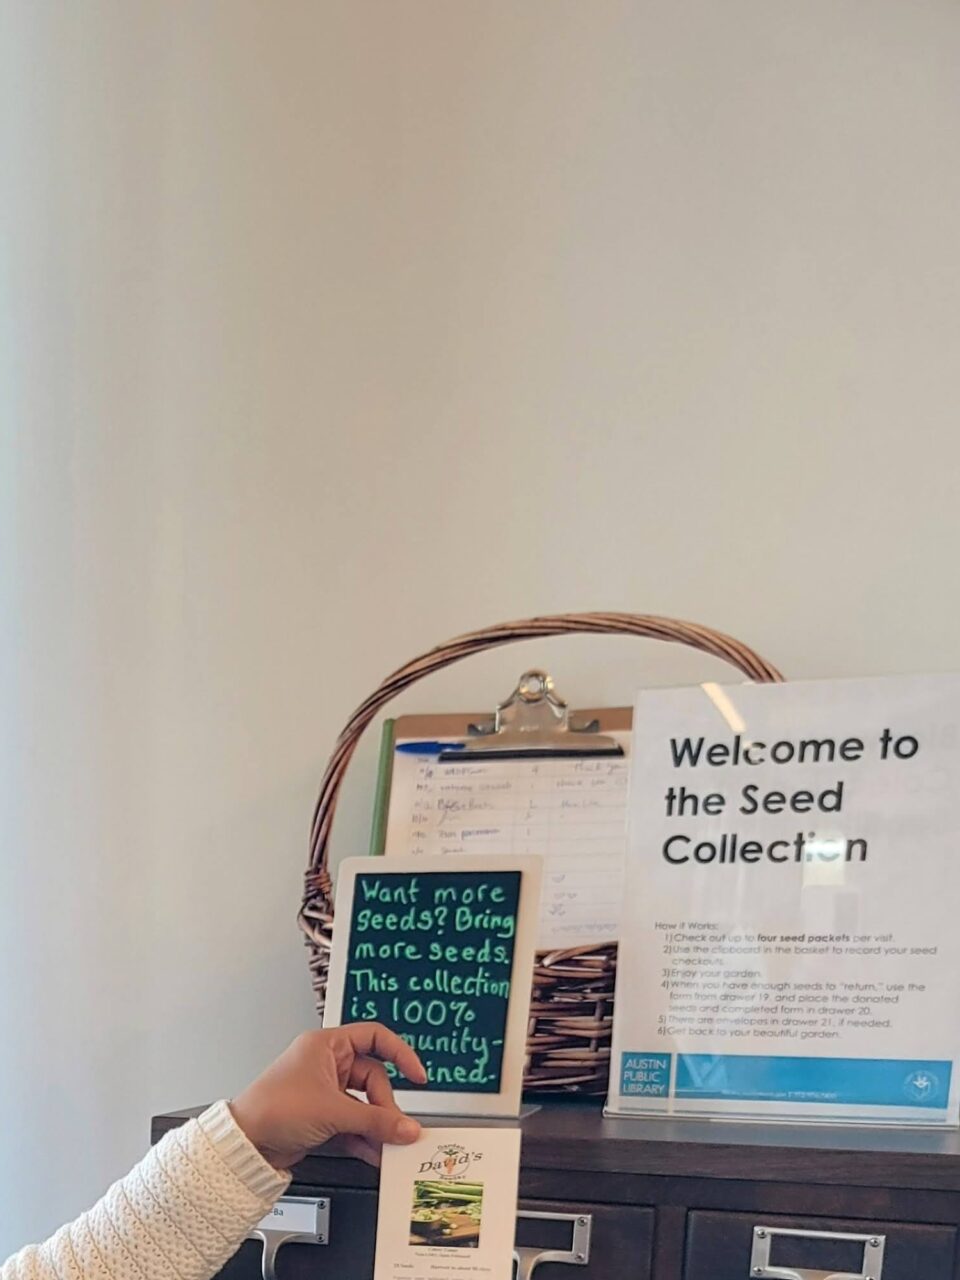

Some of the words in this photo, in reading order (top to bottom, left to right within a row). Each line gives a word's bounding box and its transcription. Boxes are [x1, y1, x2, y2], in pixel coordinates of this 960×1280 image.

[670, 735, 864, 768] Welcome
[880, 728, 919, 760] to
[665, 786, 725, 817] the
[739, 781, 844, 815] Seed
[662, 832, 868, 865] Collection
[362, 878, 419, 904] Want
[434, 884, 505, 904] more
[456, 906, 515, 938] Bring
[655, 922, 677, 930] How
[674, 933, 706, 942] Check
[709, 934, 726, 942] out
[729, 936, 742, 944] up
[745, 934, 755, 942] to
[757, 933, 776, 942] four
[780, 933, 805, 943] seed
[808, 933, 851, 944] packets
[853, 935, 872, 944] per
[355, 942, 422, 960] more
[429, 938, 510, 964] seeds.
[673, 946, 690, 954] Use
[693, 945, 709, 954] the
[711, 945, 761, 955] clipboard
[764, 945, 772, 953] in
[775, 945, 792, 954] the
[795, 946, 830, 954] basket
[833, 946, 843, 954] to
[845, 946, 881, 955] record
[884, 948, 908, 957] your
[910, 946, 938, 955] seed
[671, 970, 697, 980] Enjoy
[700, 971, 720, 980] your
[349, 968, 399, 992] This
[409, 966, 510, 999] collection
[671, 981, 699, 989] When
[702, 982, 720, 991] you
[723, 982, 748, 990] have
[751, 982, 790, 992] enough
[794, 982, 823, 991] seeds
[826, 983, 836, 991] to
[886, 984, 905, 992] use
[908, 983, 926, 992] the
[670, 991, 692, 1000] form
[695, 992, 717, 1000] from
[720, 992, 755, 1001] drawer
[776, 993, 796, 1002] and
[798, 994, 829, 1003] place
[832, 994, 849, 1002] the
[852, 994, 899, 1003] donated
[351, 996, 378, 1019] is
[393, 997, 476, 1027] 100%
[699, 1004, 719, 1012] and
[721, 1005, 778, 1014] completed
[781, 1005, 804, 1014] form
[807, 1006, 815, 1014] in
[818, 1005, 855, 1015] drawer
[698, 1016, 713, 1024] are
[716, 1016, 768, 1026] envelopes
[770, 1017, 779, 1025] in
[782, 1017, 818, 1026] drawer
[839, 1018, 845, 1026] if
[689, 1027, 714, 1036] back
[717, 1028, 727, 1036] to
[730, 1030, 751, 1038] your
[753, 1028, 798, 1038] beautiful
[625, 1058, 667, 1070] AUSTIN
[623, 1070, 661, 1082] PUBLIC
[623, 1083, 666, 1095] LIBRARY
[418, 1151, 483, 1173] David's
